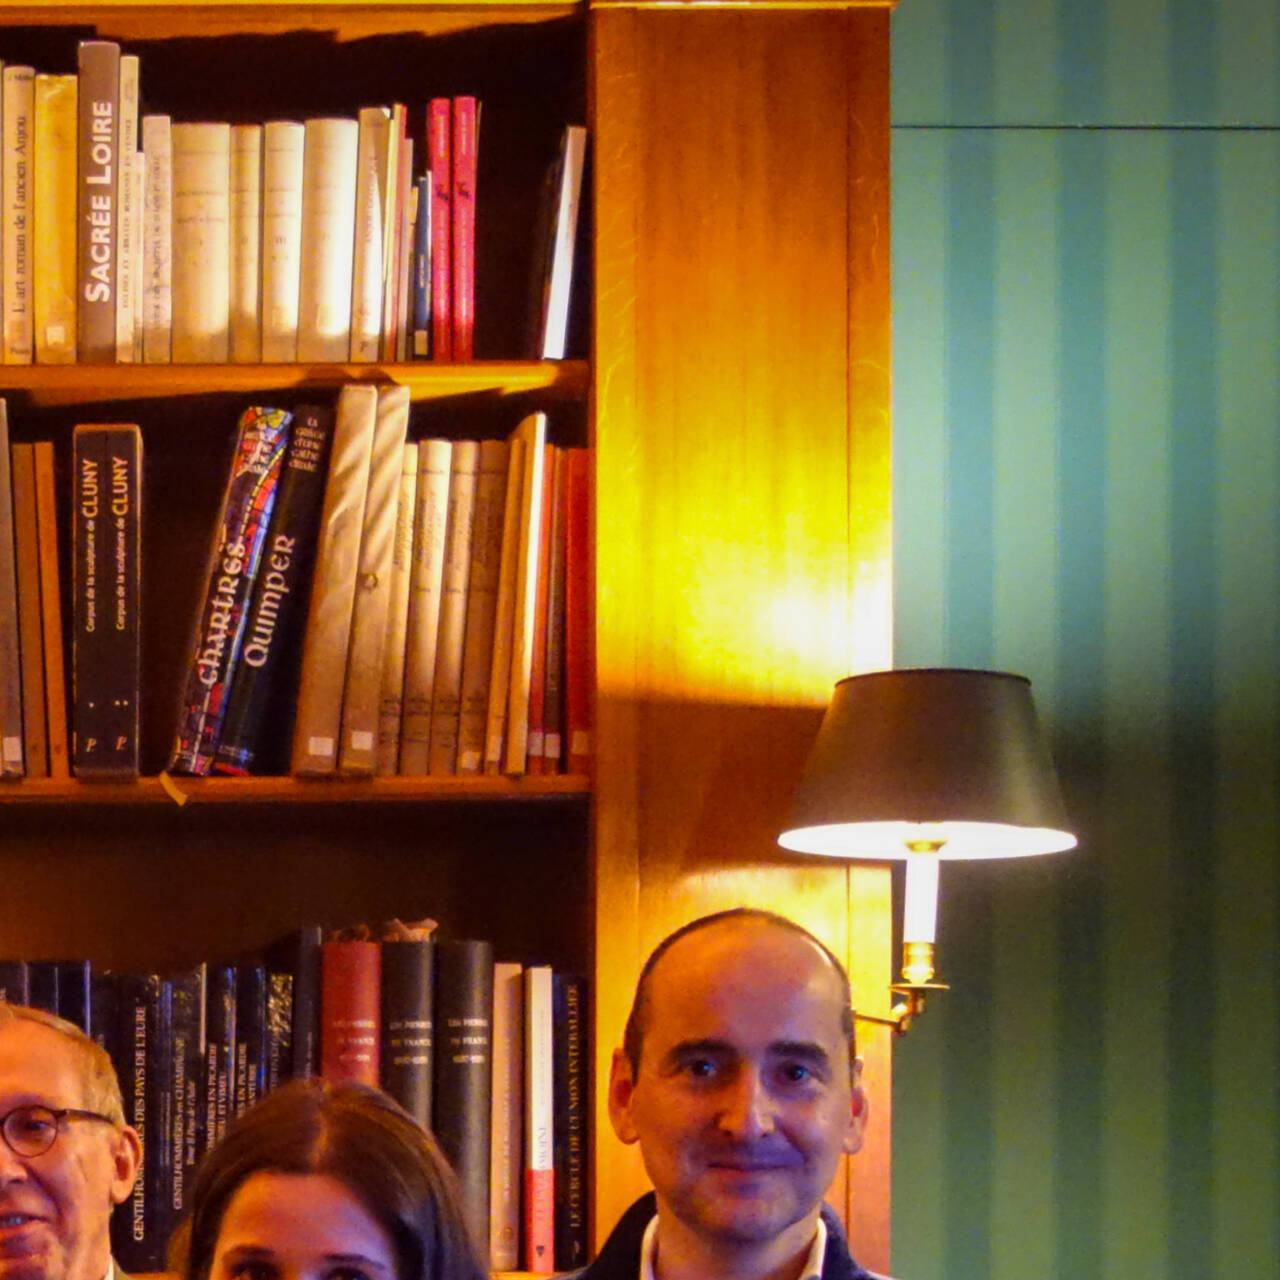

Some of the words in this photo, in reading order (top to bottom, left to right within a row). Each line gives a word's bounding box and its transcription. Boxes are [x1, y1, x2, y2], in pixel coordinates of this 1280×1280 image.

[14, 115, 28, 156] Anjou
[85, 101, 113, 184] LOIRE
[13, 215, 26, 230] de
[83, 195, 112, 302] SACRÉE
[81, 458, 99, 518] CLUNY
[111, 456, 130, 516] CLUNY
[85, 520, 96, 531] de
[115, 518, 126, 529] de
[85, 577, 96, 585] la
[115, 575, 126, 583] la
[85, 588, 96, 599] de
[115, 586, 126, 597] de
[85, 601, 96, 632] Corpus
[115, 599, 126, 630] Corpus
[134, 1006, 147, 1047] L'EURE
[134, 1050, 146, 1066] DE
[207, 1043, 217, 1086] PICARDIE
[134, 1068, 146, 1097] PAYS
[207, 1087, 217, 1100] EN
[134, 1099, 146, 1121] DES
[568, 1135, 580, 1152] DE
